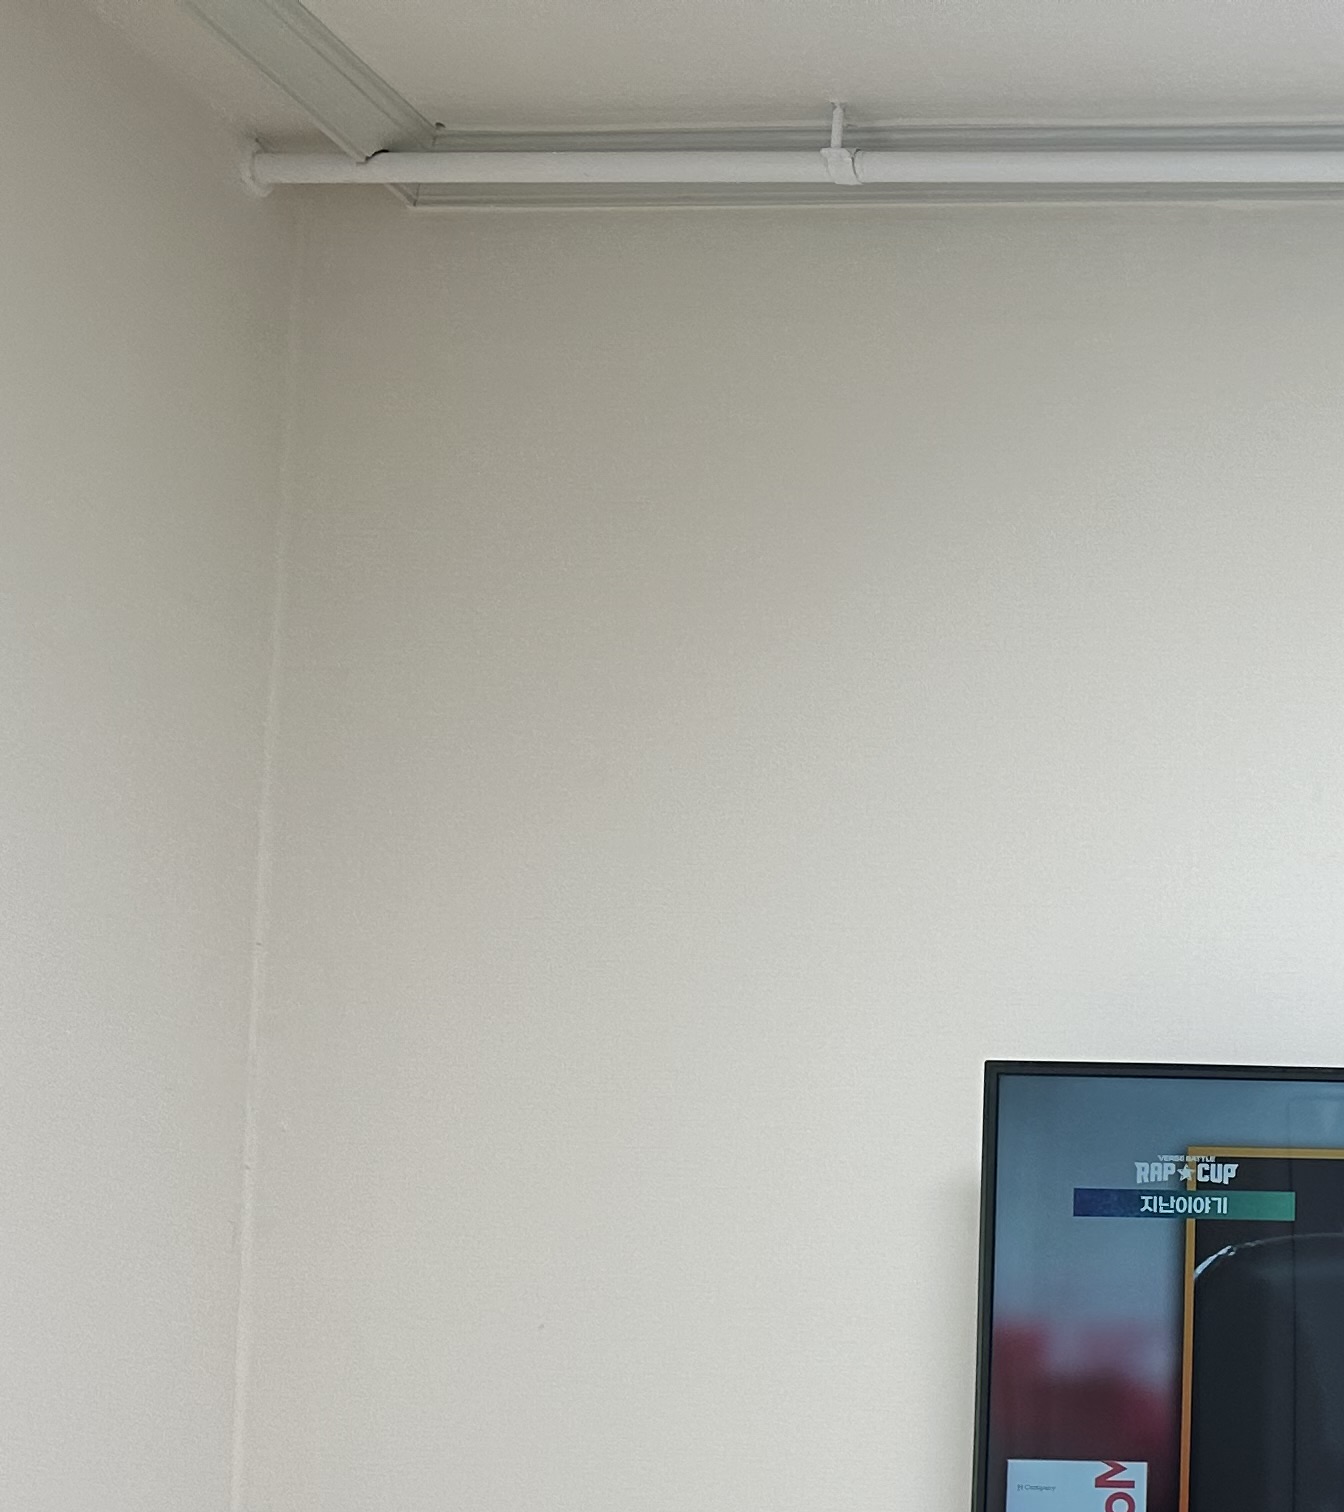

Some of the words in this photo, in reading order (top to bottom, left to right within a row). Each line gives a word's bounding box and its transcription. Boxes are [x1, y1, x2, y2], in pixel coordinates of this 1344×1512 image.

[1134, 1162, 1176, 1184] RAP
[1197, 1163, 1239, 1185] CUP
[1139, 1195, 1228, 1214] 지난이야기
